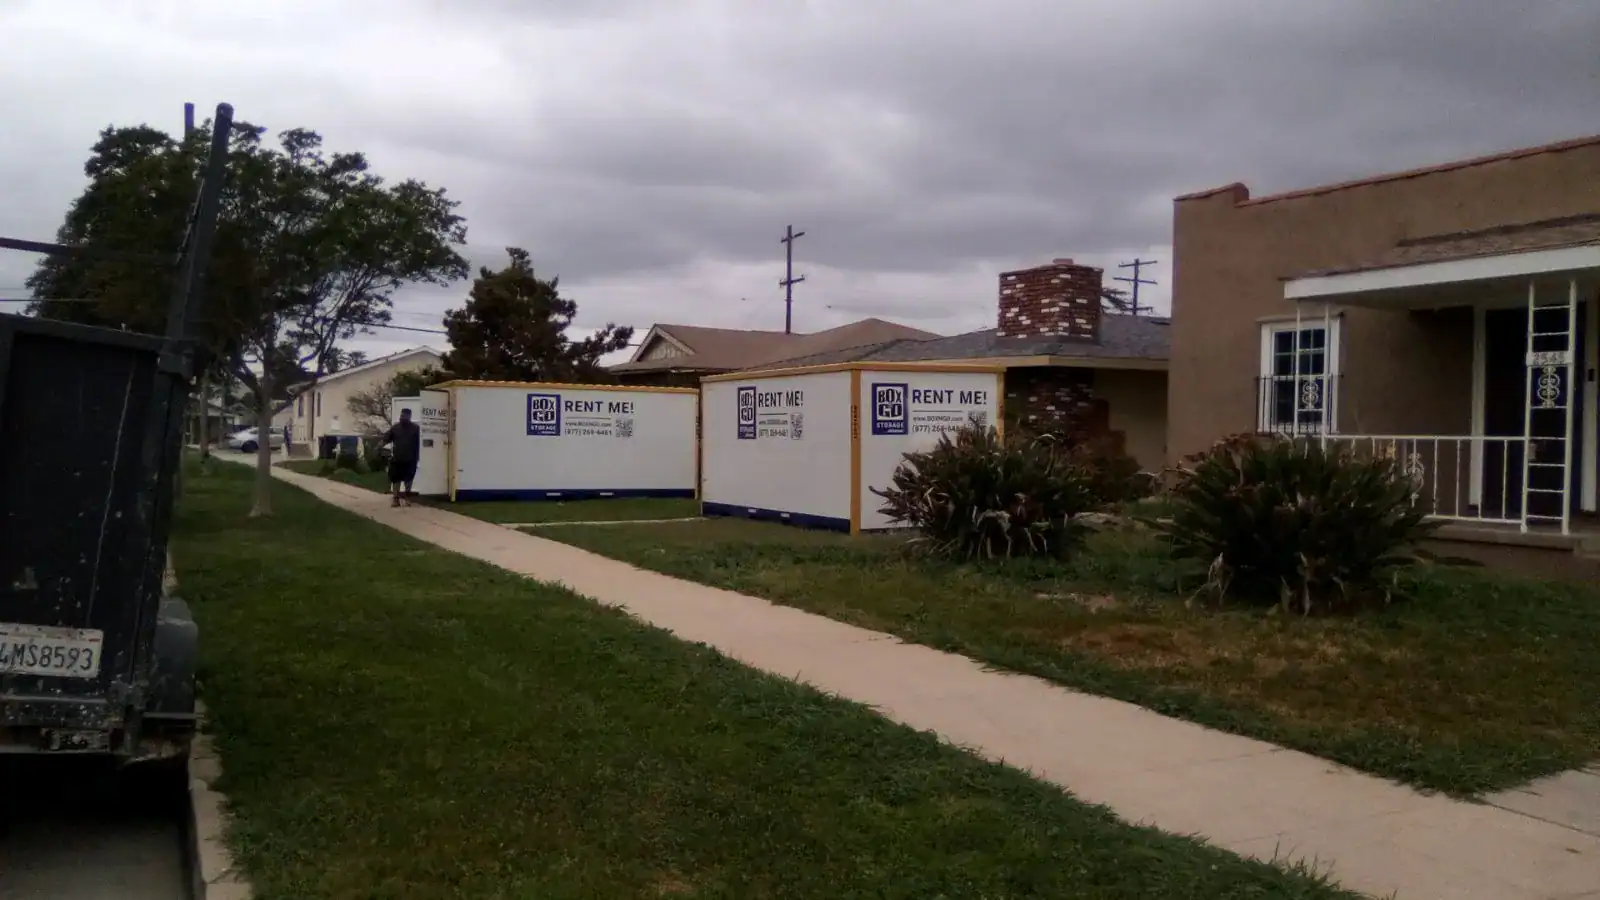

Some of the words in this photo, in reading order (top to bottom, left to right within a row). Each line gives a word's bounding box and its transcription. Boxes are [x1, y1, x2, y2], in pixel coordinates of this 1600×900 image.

[758, 391, 783, 408] RENT
[786, 390, 804, 407] ME!
[878, 388, 902, 403] BOX
[912, 389, 954, 404] RENT
[960, 390, 987, 405] ME!
[532, 398, 555, 410] BOX
[564, 400, 604, 412] RENT
[609, 401, 634, 414] ME!
[878, 403, 902, 418] GO
[422, 407, 437, 417] RENT
[876, 421, 904, 429] STORAGE
[912, 424, 931, 434] (877)
